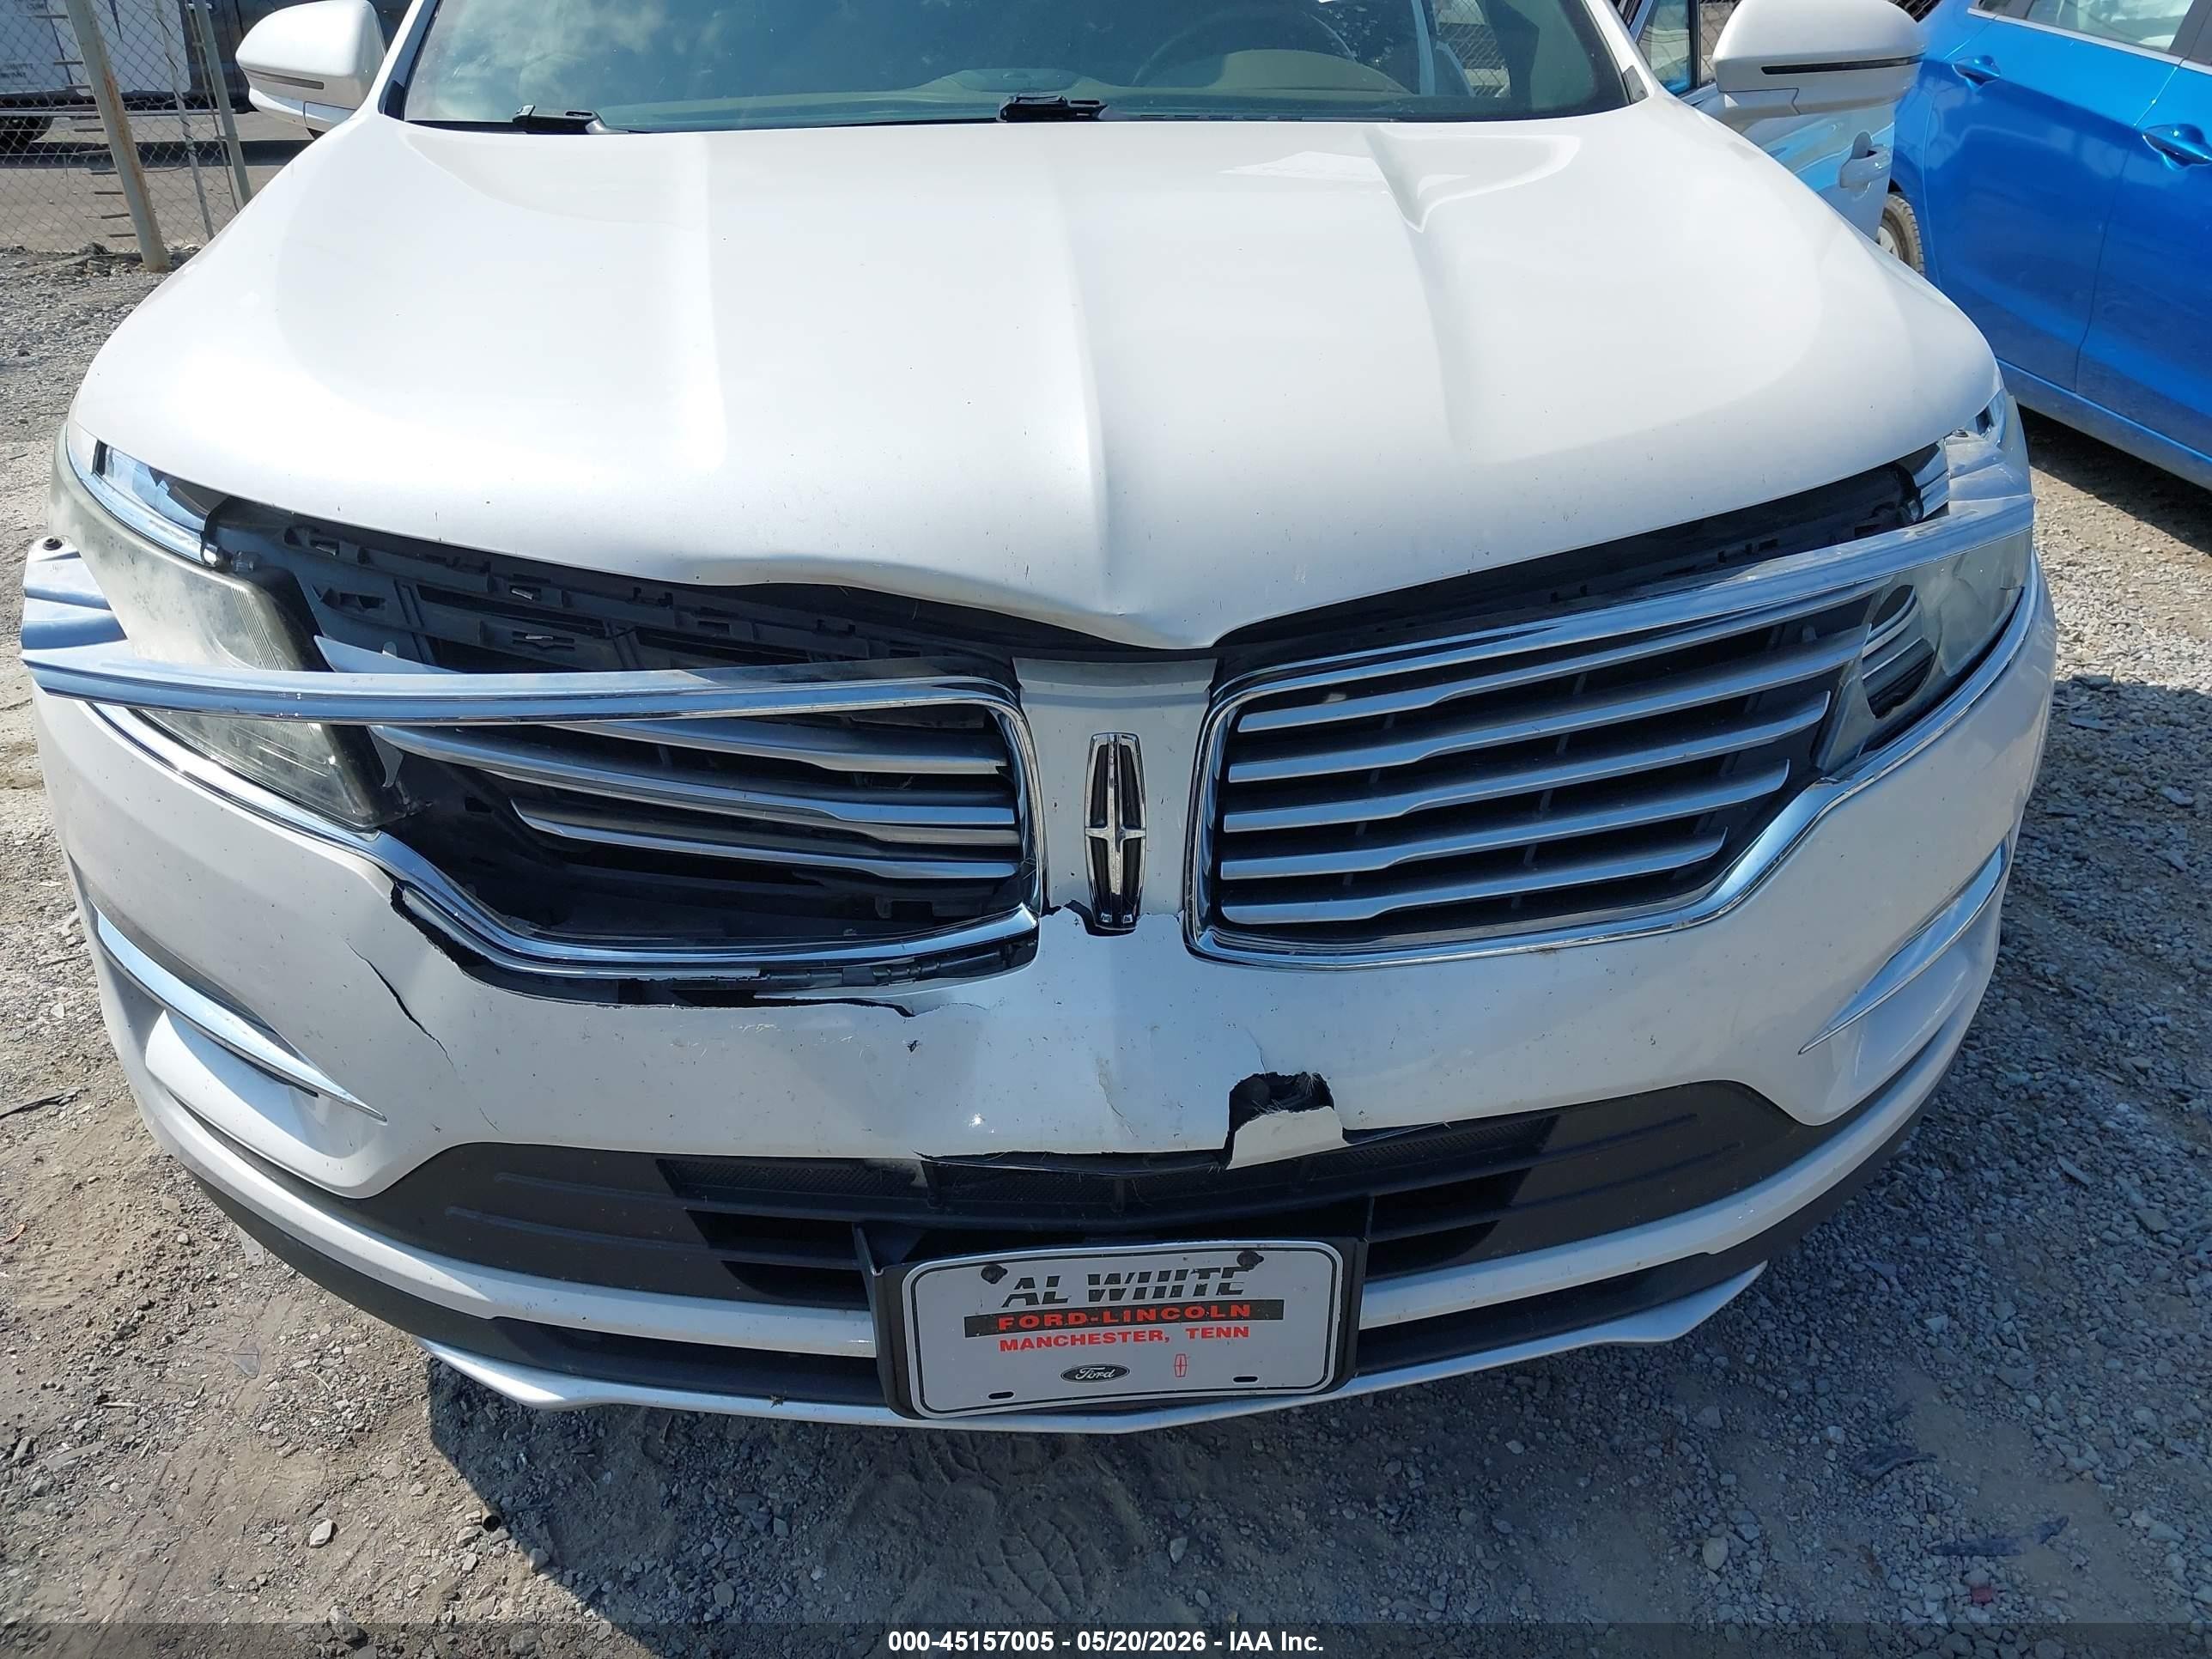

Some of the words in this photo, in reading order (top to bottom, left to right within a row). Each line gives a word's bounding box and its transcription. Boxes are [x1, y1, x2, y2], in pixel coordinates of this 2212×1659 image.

[1001, 1275, 1069, 1308] AL
[1087, 1267, 1250, 1303] WHITE
[998, 1304, 1251, 1330] FORD-LINCOLN
[1000, 1329, 1170, 1352] MANCHESTER,
[1186, 1326, 1249, 1340] TENN
[1075, 1367, 1115, 1380] Ford
